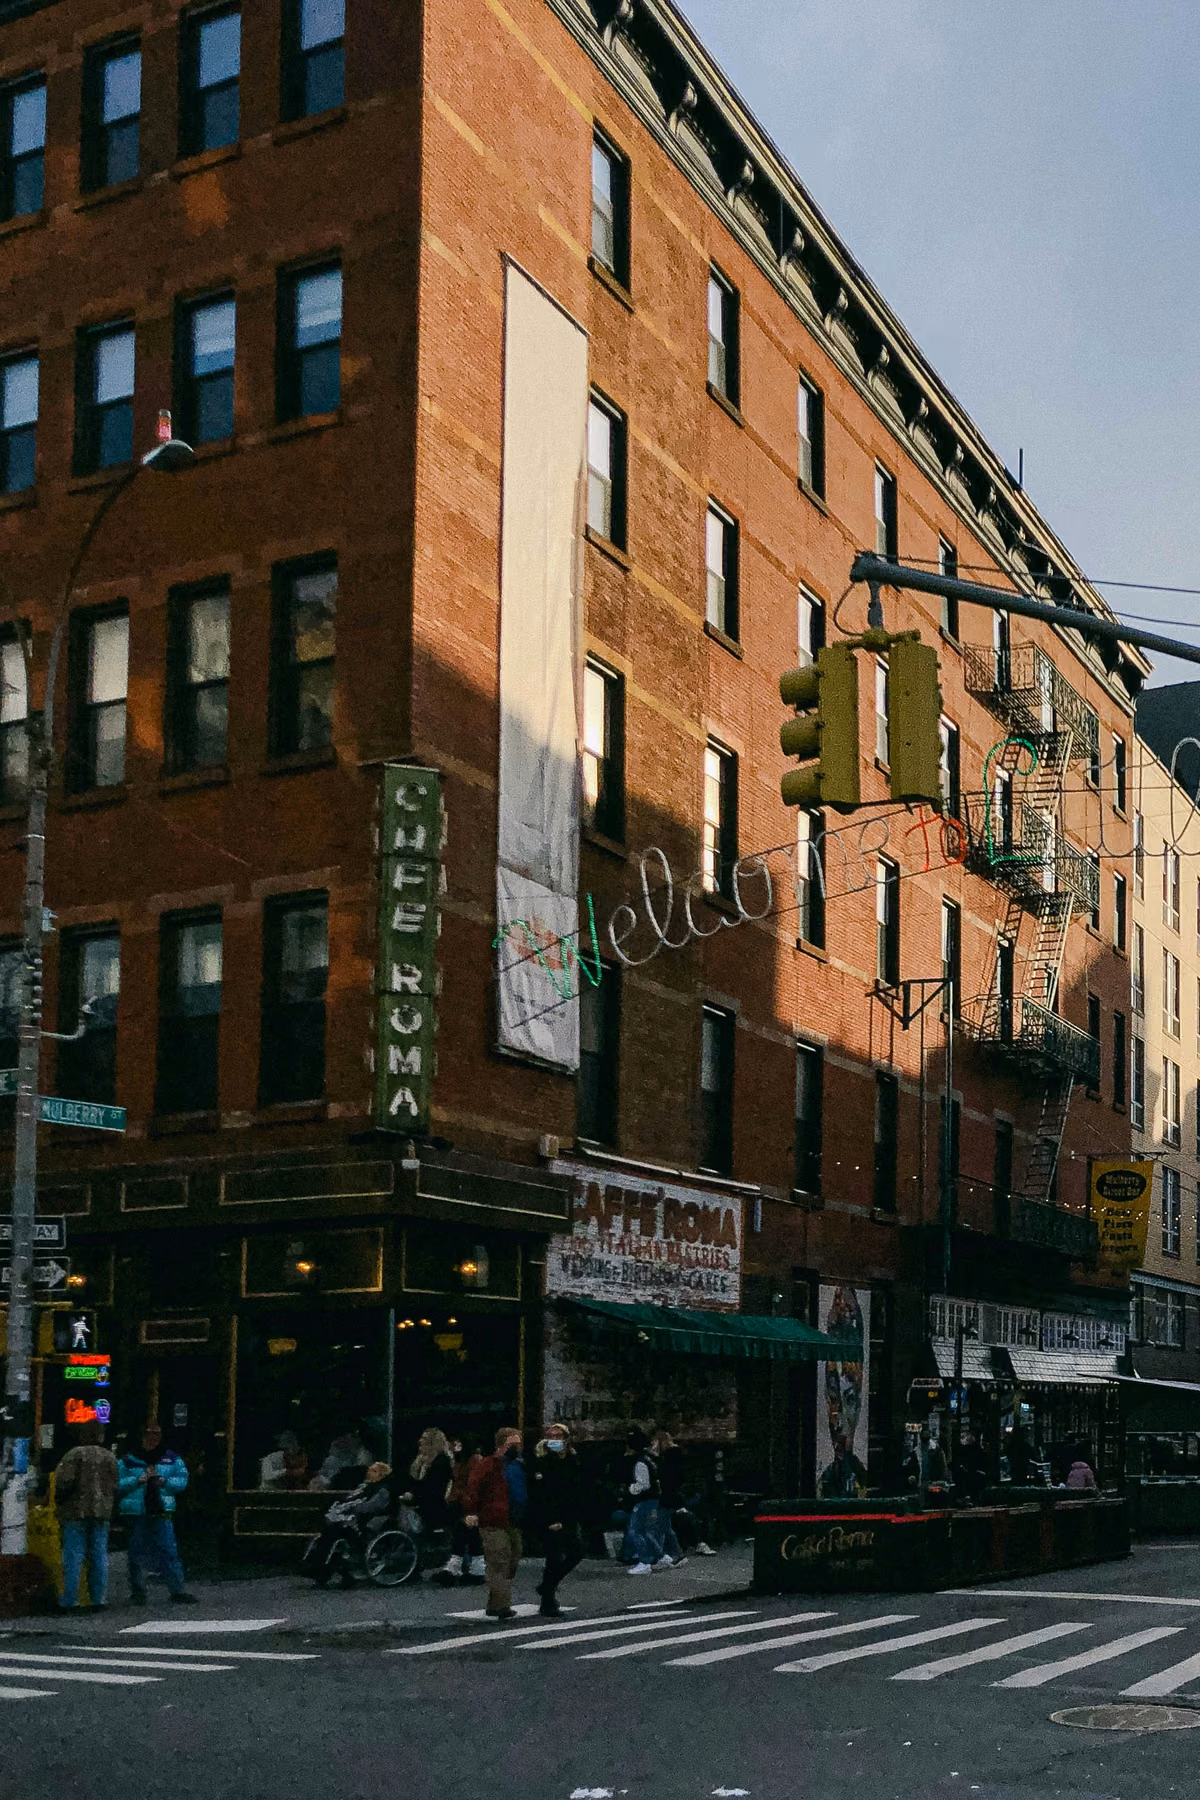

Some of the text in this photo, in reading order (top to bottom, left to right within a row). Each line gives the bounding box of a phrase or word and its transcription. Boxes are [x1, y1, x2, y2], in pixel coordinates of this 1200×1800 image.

[493, 818, 897, 1000] Welcome
[905, 804, 966, 872] to
[386, 963, 422, 1116] ROMA
[41, 1101, 122, 1125] MULBERRY ST
[663, 1197, 738, 1249] ROMA
